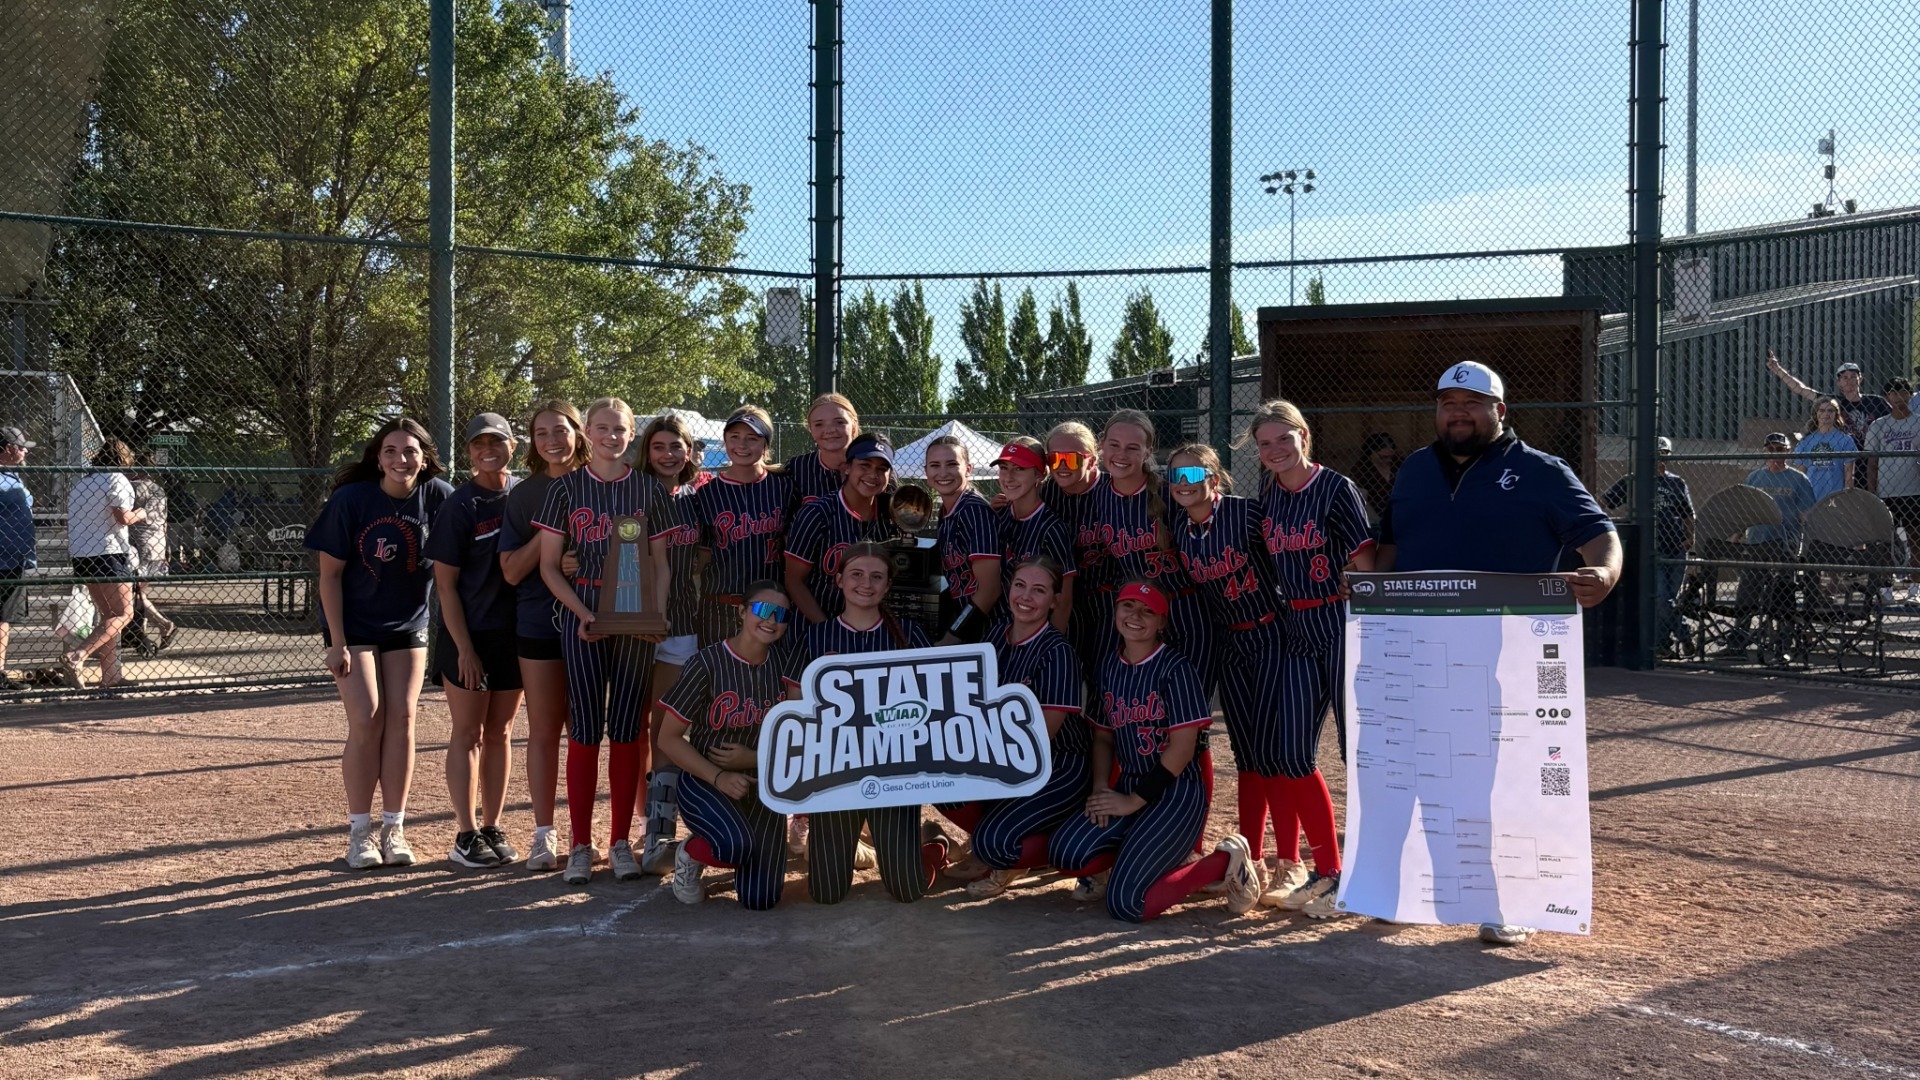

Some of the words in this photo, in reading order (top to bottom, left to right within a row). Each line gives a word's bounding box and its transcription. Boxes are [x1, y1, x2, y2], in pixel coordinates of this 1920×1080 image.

[1452, 366, 1469, 384] LC
[1496, 468, 1520, 490] LC
[374, 537, 398, 562] LC
[1144, 548, 1180, 578] 33
[1309, 553, 1331, 582] 8
[950, 569, 980, 599] 22
[1223, 566, 1259, 601] 44
[1383, 580, 1413, 590] STATE
[1415, 579, 1477, 590] FASTPITCH
[1538, 578, 1568, 596] 1B
[820, 660, 979, 727] STATE
[883, 707, 919, 721] WIAA
[772, 699, 1038, 793] CHAMPIONS
[882, 783, 903, 792] Gesa
[904, 781, 930, 791] Credit
[932, 779, 955, 789] Union
[1545, 903, 1578, 915] Baden
